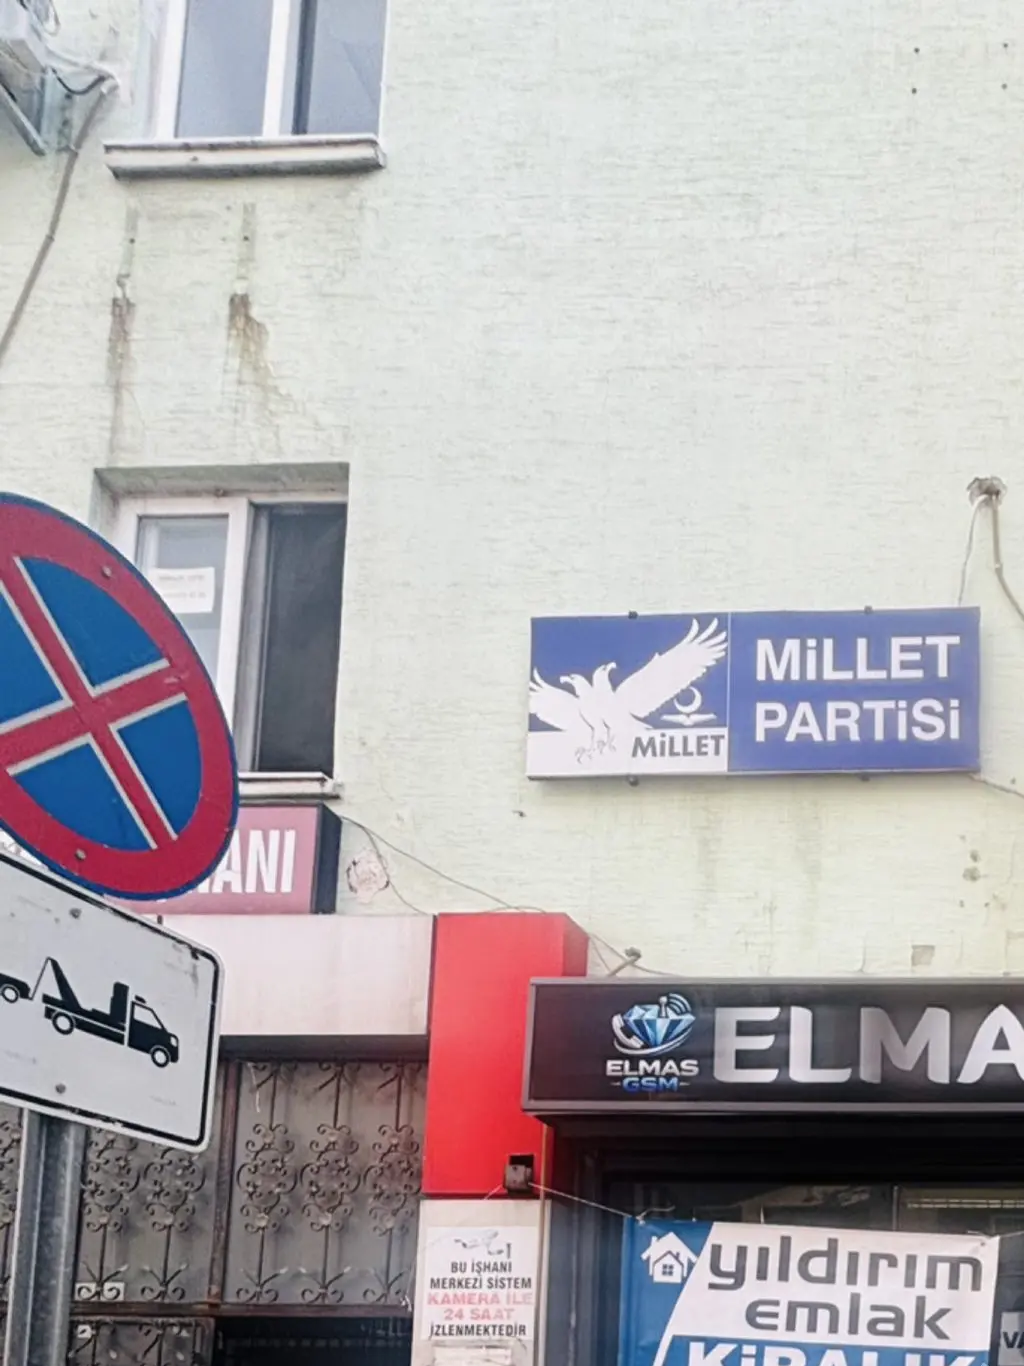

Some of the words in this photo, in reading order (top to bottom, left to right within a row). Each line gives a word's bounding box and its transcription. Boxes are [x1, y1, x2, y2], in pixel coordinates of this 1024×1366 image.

[193, 829, 297, 894] ANI
[606, 1059, 699, 1077] ELMAS
[622, 1076, 679, 1093] GSM
[451, 1261, 467, 1273] BU
[427, 1292, 501, 1305] KAMERA
[444, 1308, 464, 1320] 24
[470, 1308, 515, 1320] SAAT
[745, 1293, 953, 1340] emlak
